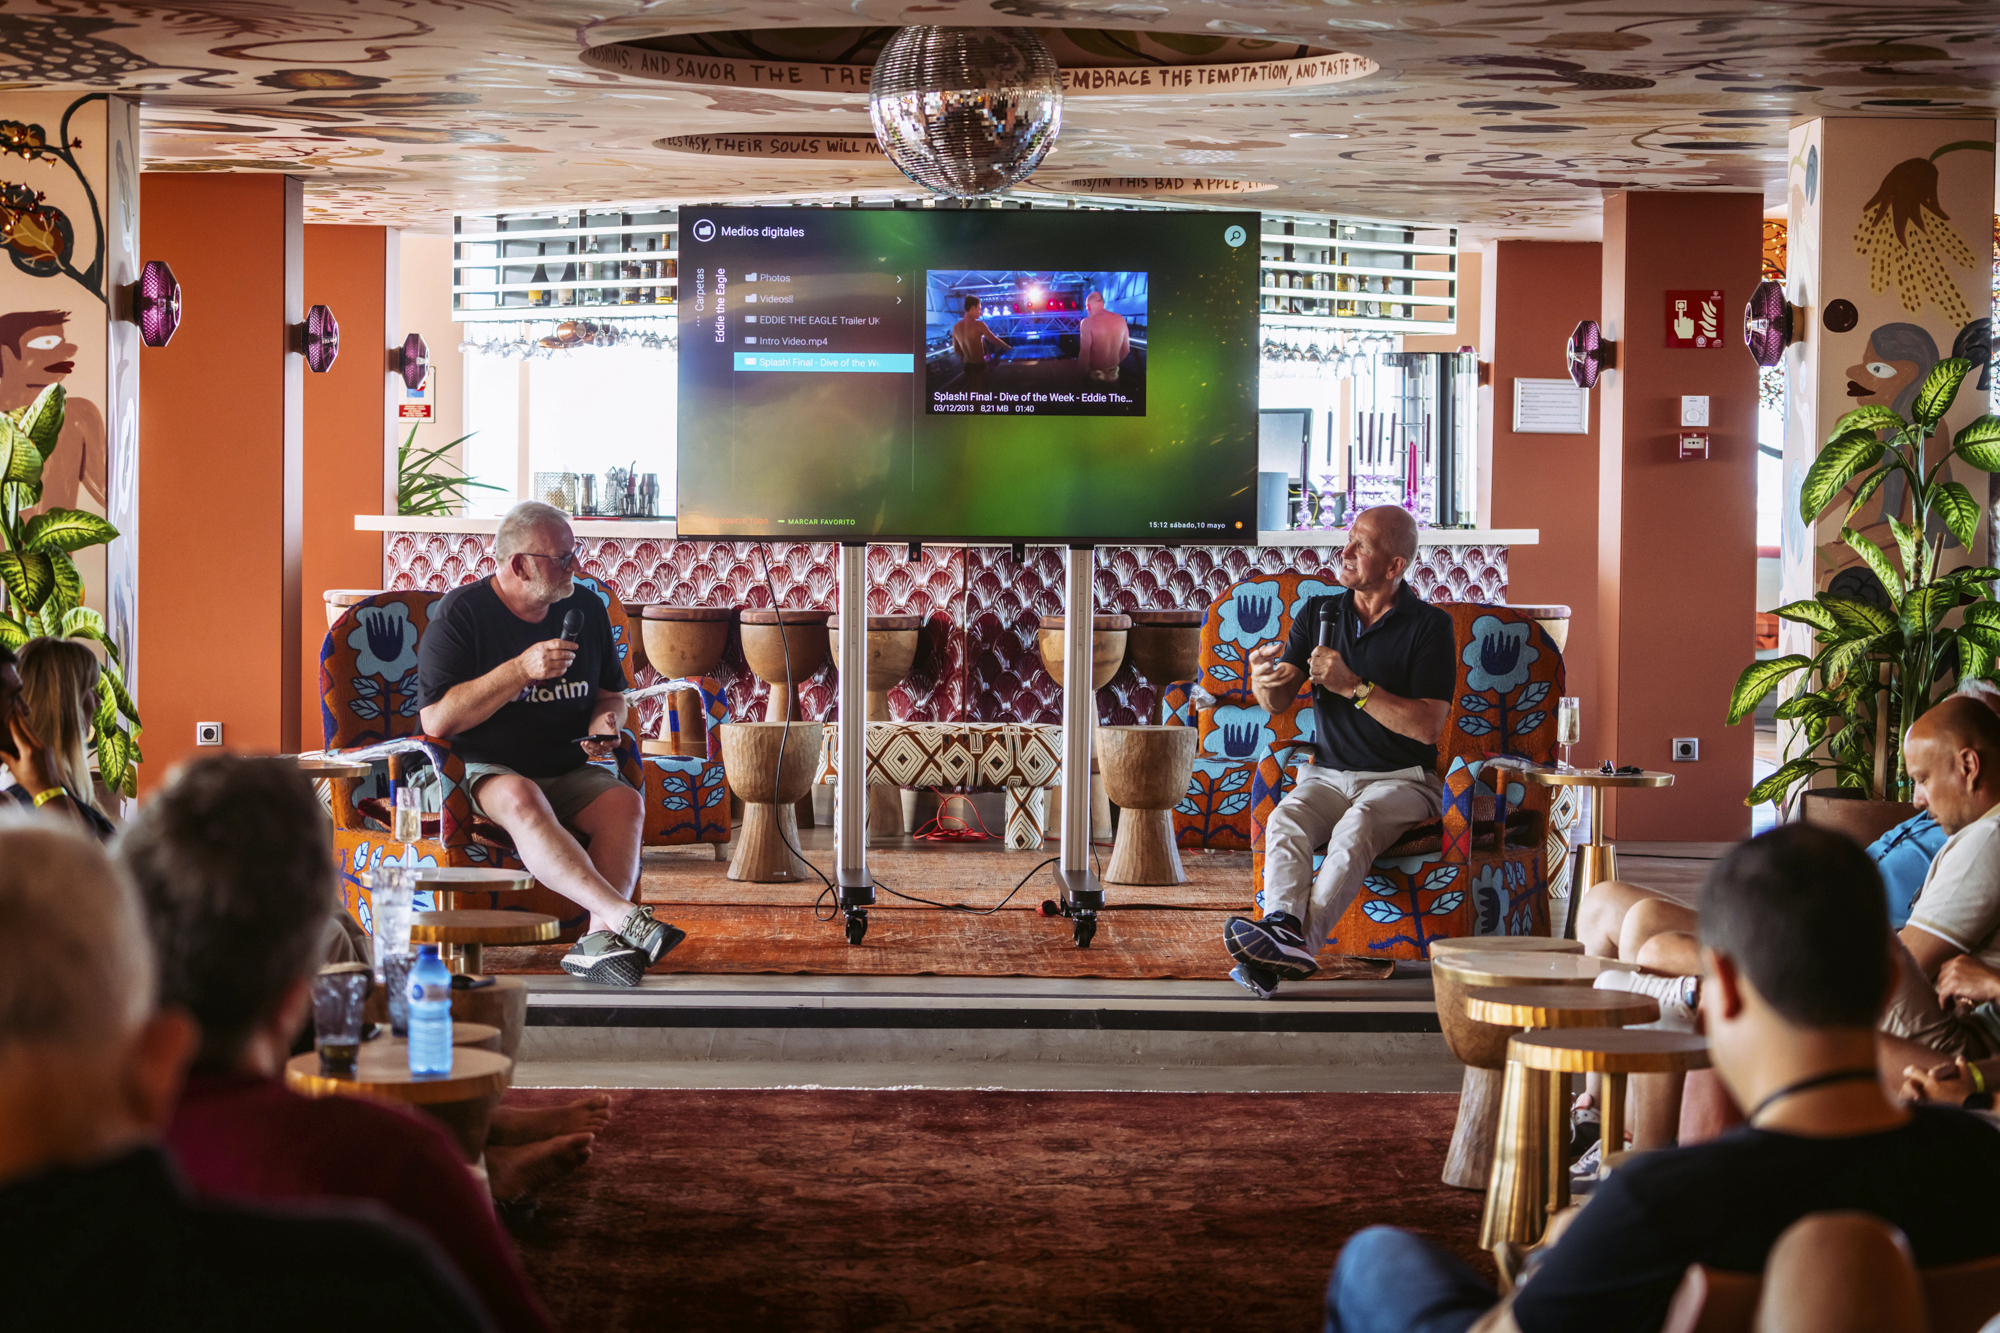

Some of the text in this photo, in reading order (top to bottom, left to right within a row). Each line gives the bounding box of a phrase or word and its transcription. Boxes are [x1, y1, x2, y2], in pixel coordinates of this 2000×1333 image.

[641, 52, 670, 75] AND
[676, 57, 736, 82] SAVOR
[750, 64, 802, 83] THE
[1061, 70, 1151, 90] EMBRACE
[1159, 69, 1193, 87] THE
[1296, 63, 1317, 80] AND
[1320, 58, 1349, 77] TASTE
[770, 139, 820, 153] SOULS
[866, 142, 885, 154] M
[1155, 178, 1184, 190] BAD
[721, 226, 805, 239] Medios digitales
[760, 273, 791, 283] Photos
[694, 268, 706, 312] Carpetas
[715, 268, 727, 343] Eddie the Eagle
[760, 315, 786, 325] EDDIE
[788, 315, 807, 325] THE
[808, 315, 838, 325] EAGLE
[839, 316, 866, 326] Trailer
[759, 336, 828, 347] Intro Video.mp4
[759, 357, 791, 367] Splash!
[792, 357, 813, 367] Final
[820, 357, 839, 367] Dive
[840, 357, 850, 367] of
[851, 358, 866, 368] the
[933, 391, 968, 403] Splash!
[969, 391, 993, 402] Final
[999, 392, 1019, 402] Dive
[1020, 392, 1031, 402] of
[1032, 392, 1048, 402] the
[1049, 392, 1075, 403] Week
[1081, 393, 1107, 403] Eddie
[933, 404, 1035, 413] 03/12/2013 8,21 MB 01:40
[749, 517, 769, 525] TODO
[787, 518, 856, 526] MARCAR FAVORITO
[1149, 521, 1168, 529] 15:12
[1206, 522, 1226, 530] mayo
